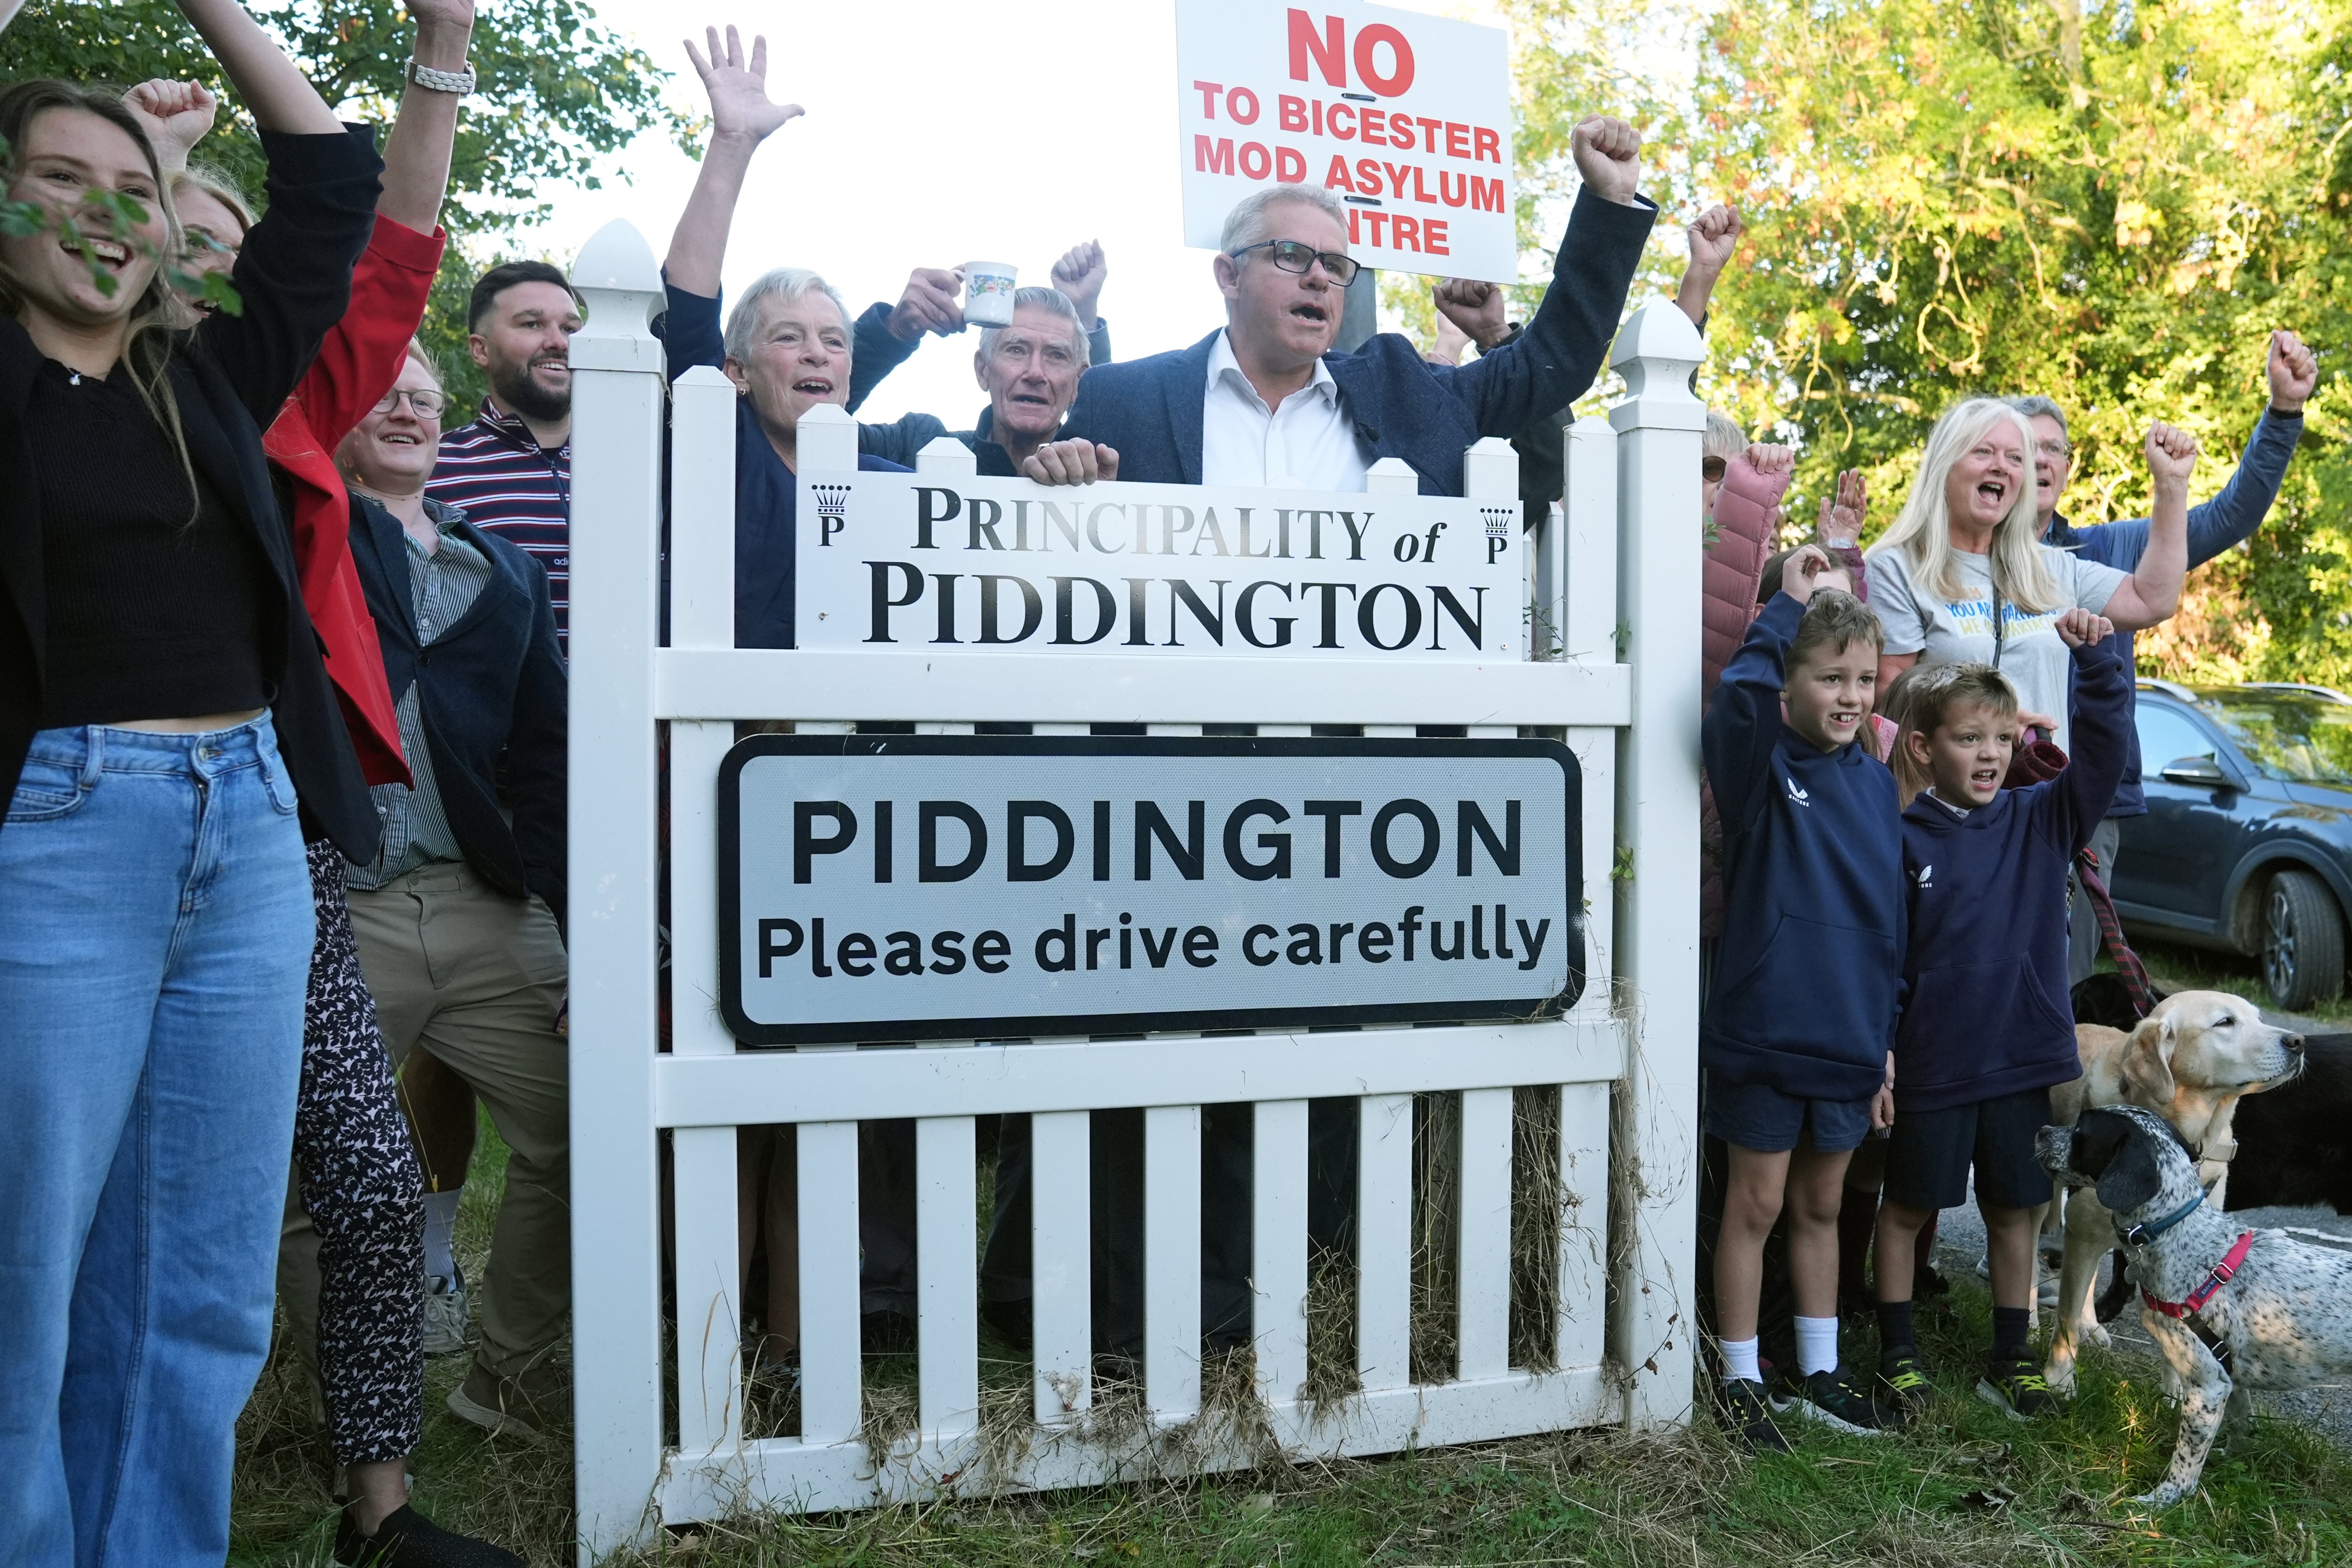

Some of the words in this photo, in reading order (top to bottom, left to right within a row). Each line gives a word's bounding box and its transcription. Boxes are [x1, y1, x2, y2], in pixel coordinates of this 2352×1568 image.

[1287, 8, 1414, 97] NO
[1193, 80, 1260, 126] TO
[1278, 94, 1501, 164] BICESTER
[1194, 134, 1307, 183] MOD
[1325, 155, 1505, 214] ASYLUM
[1342, 208, 1449, 256] NTRE
[818, 516, 844, 547] P
[910, 487, 1375, 560] PRINCIPALITY
[1394, 522, 1447, 563] of
[1486, 536, 1507, 565] P
[554, 557, 568, 566] adi
[862, 561, 1490, 651] PIDDINGTON
[1945, 603, 1975, 617] YOU
[1976, 602, 1993, 621] AR
[1959, 618, 1981, 635] WE
[794, 799, 1521, 884] PIDDINGTON
[759, 918, 1011, 978] Please
[1035, 911, 1219, 972] drive
[1243, 905, 1551, 971] carefully
[2201, 1284, 2211, 1295] EASY
